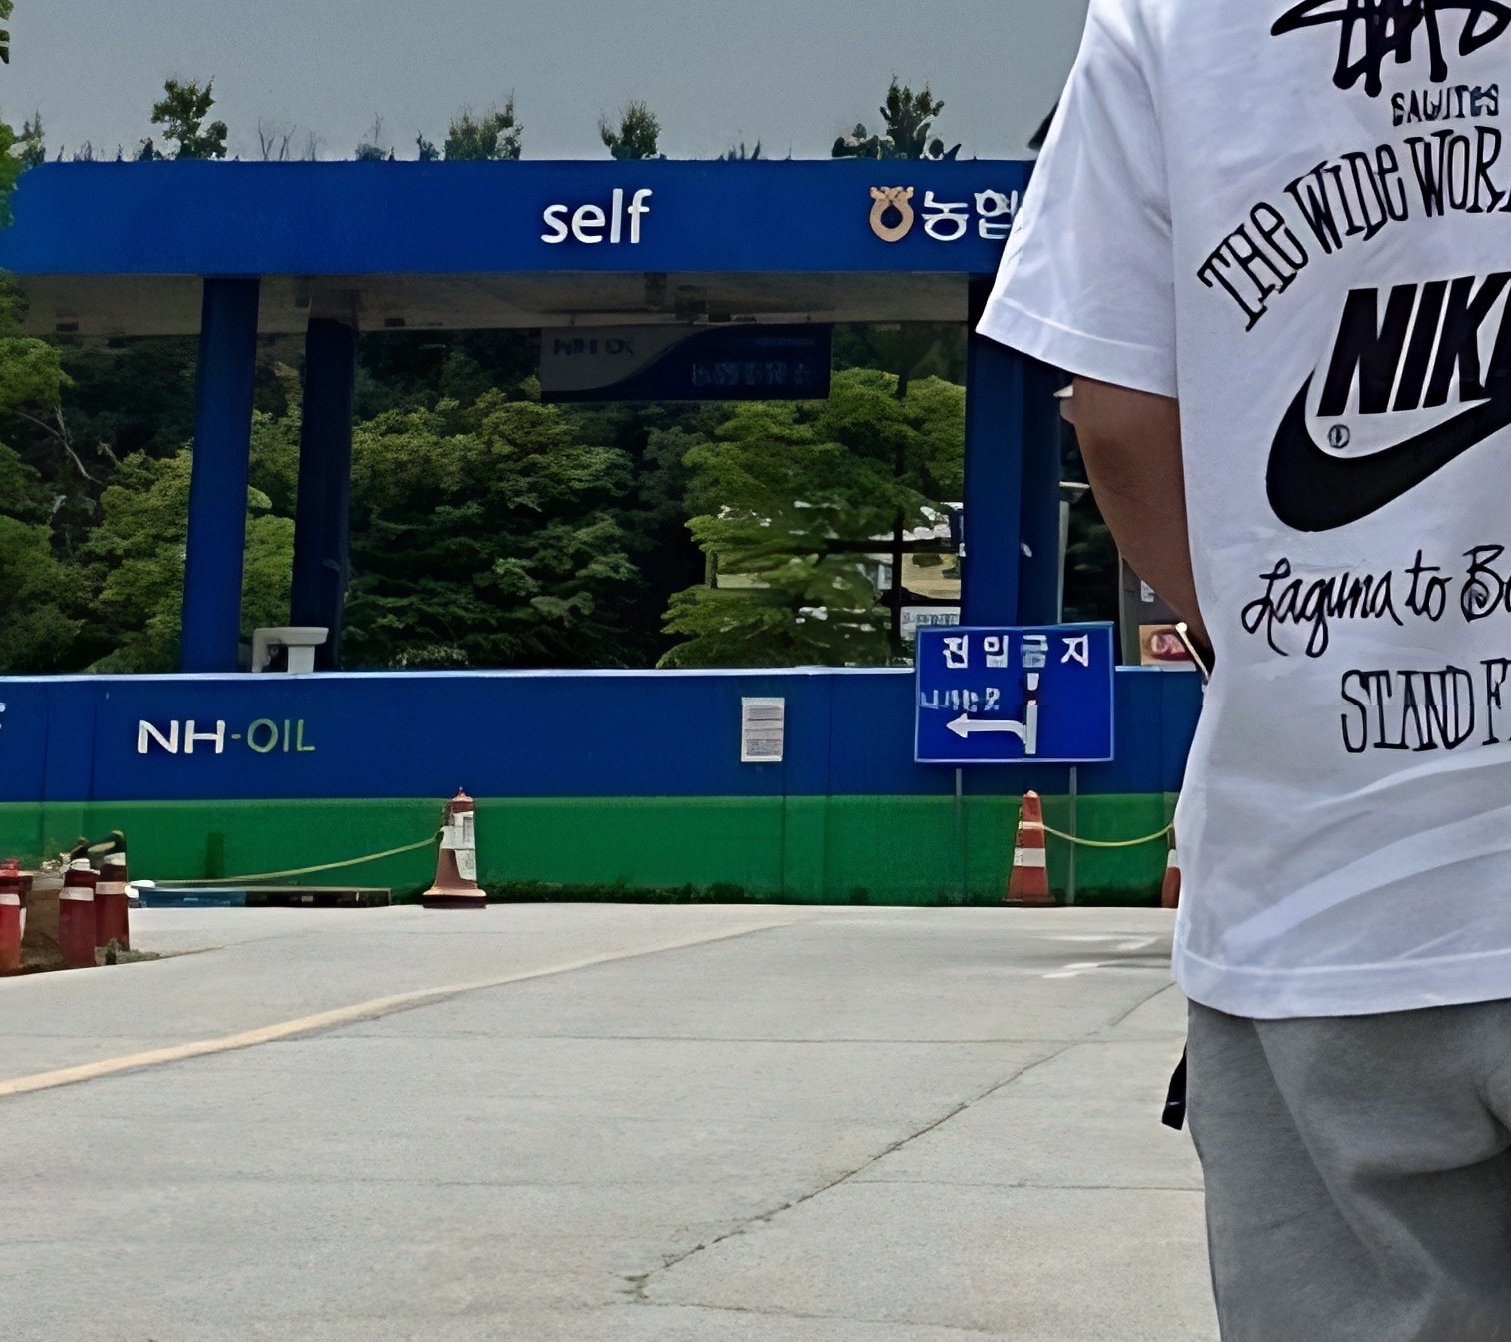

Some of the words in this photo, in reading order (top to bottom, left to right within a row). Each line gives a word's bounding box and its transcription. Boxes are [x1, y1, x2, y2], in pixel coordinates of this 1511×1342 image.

[540, 188, 653, 244] self
[1241, 557, 1403, 657] Laguna
[1404, 549, 1452, 622] to
[1340, 665, 1475, 753] STAND
